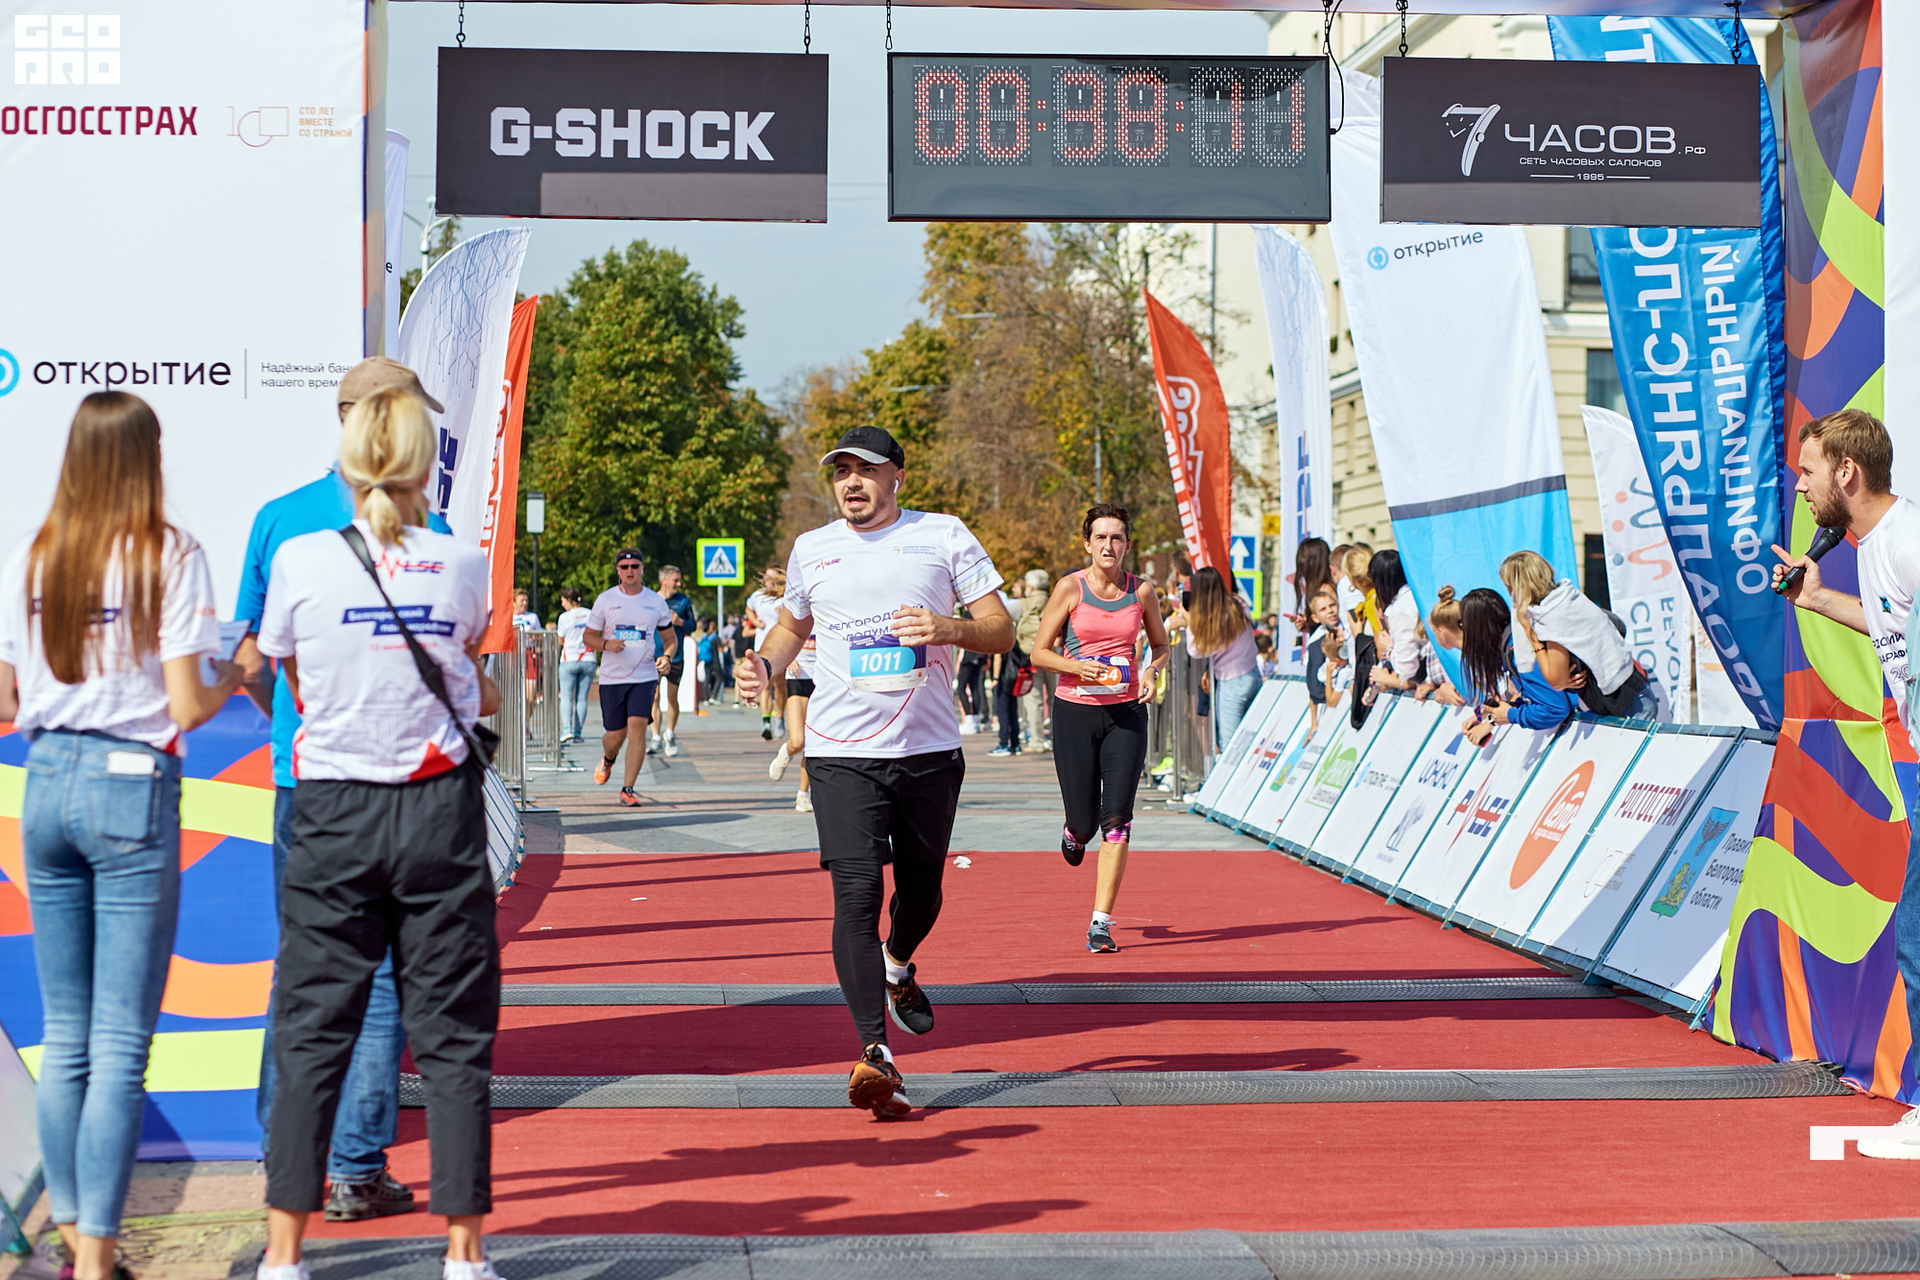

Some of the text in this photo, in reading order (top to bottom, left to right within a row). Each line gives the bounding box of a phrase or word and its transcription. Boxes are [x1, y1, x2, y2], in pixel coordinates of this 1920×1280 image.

[299, 107, 335, 115] СТО ЛЕТ
[917, 71, 1303, 160] 00:38:11
[1, 106, 198, 136] ОСГОССТРАХ
[299, 118, 334, 126] ВМЕСТЕ
[299, 128, 353, 138] СО СТРАНОЙ
[490, 106, 776, 161] G-SHOCK
[1519, 157, 1662, 168] СЕТЬ ЧАСОВЫХ САЛОНОВ
[1576, 173, 1605, 181] 1995
[1394, 231, 1483, 260] открытие
[33, 361, 232, 392] открытие
[261, 362, 324, 374] Надёжный
[261, 379, 305, 387] нашего
[620, 631, 639, 640] 1058
[861, 651, 901, 673] 1011
[1614, 782, 1697, 826] РОСГОССТРАХ
[1690, 887, 1723, 910] области
